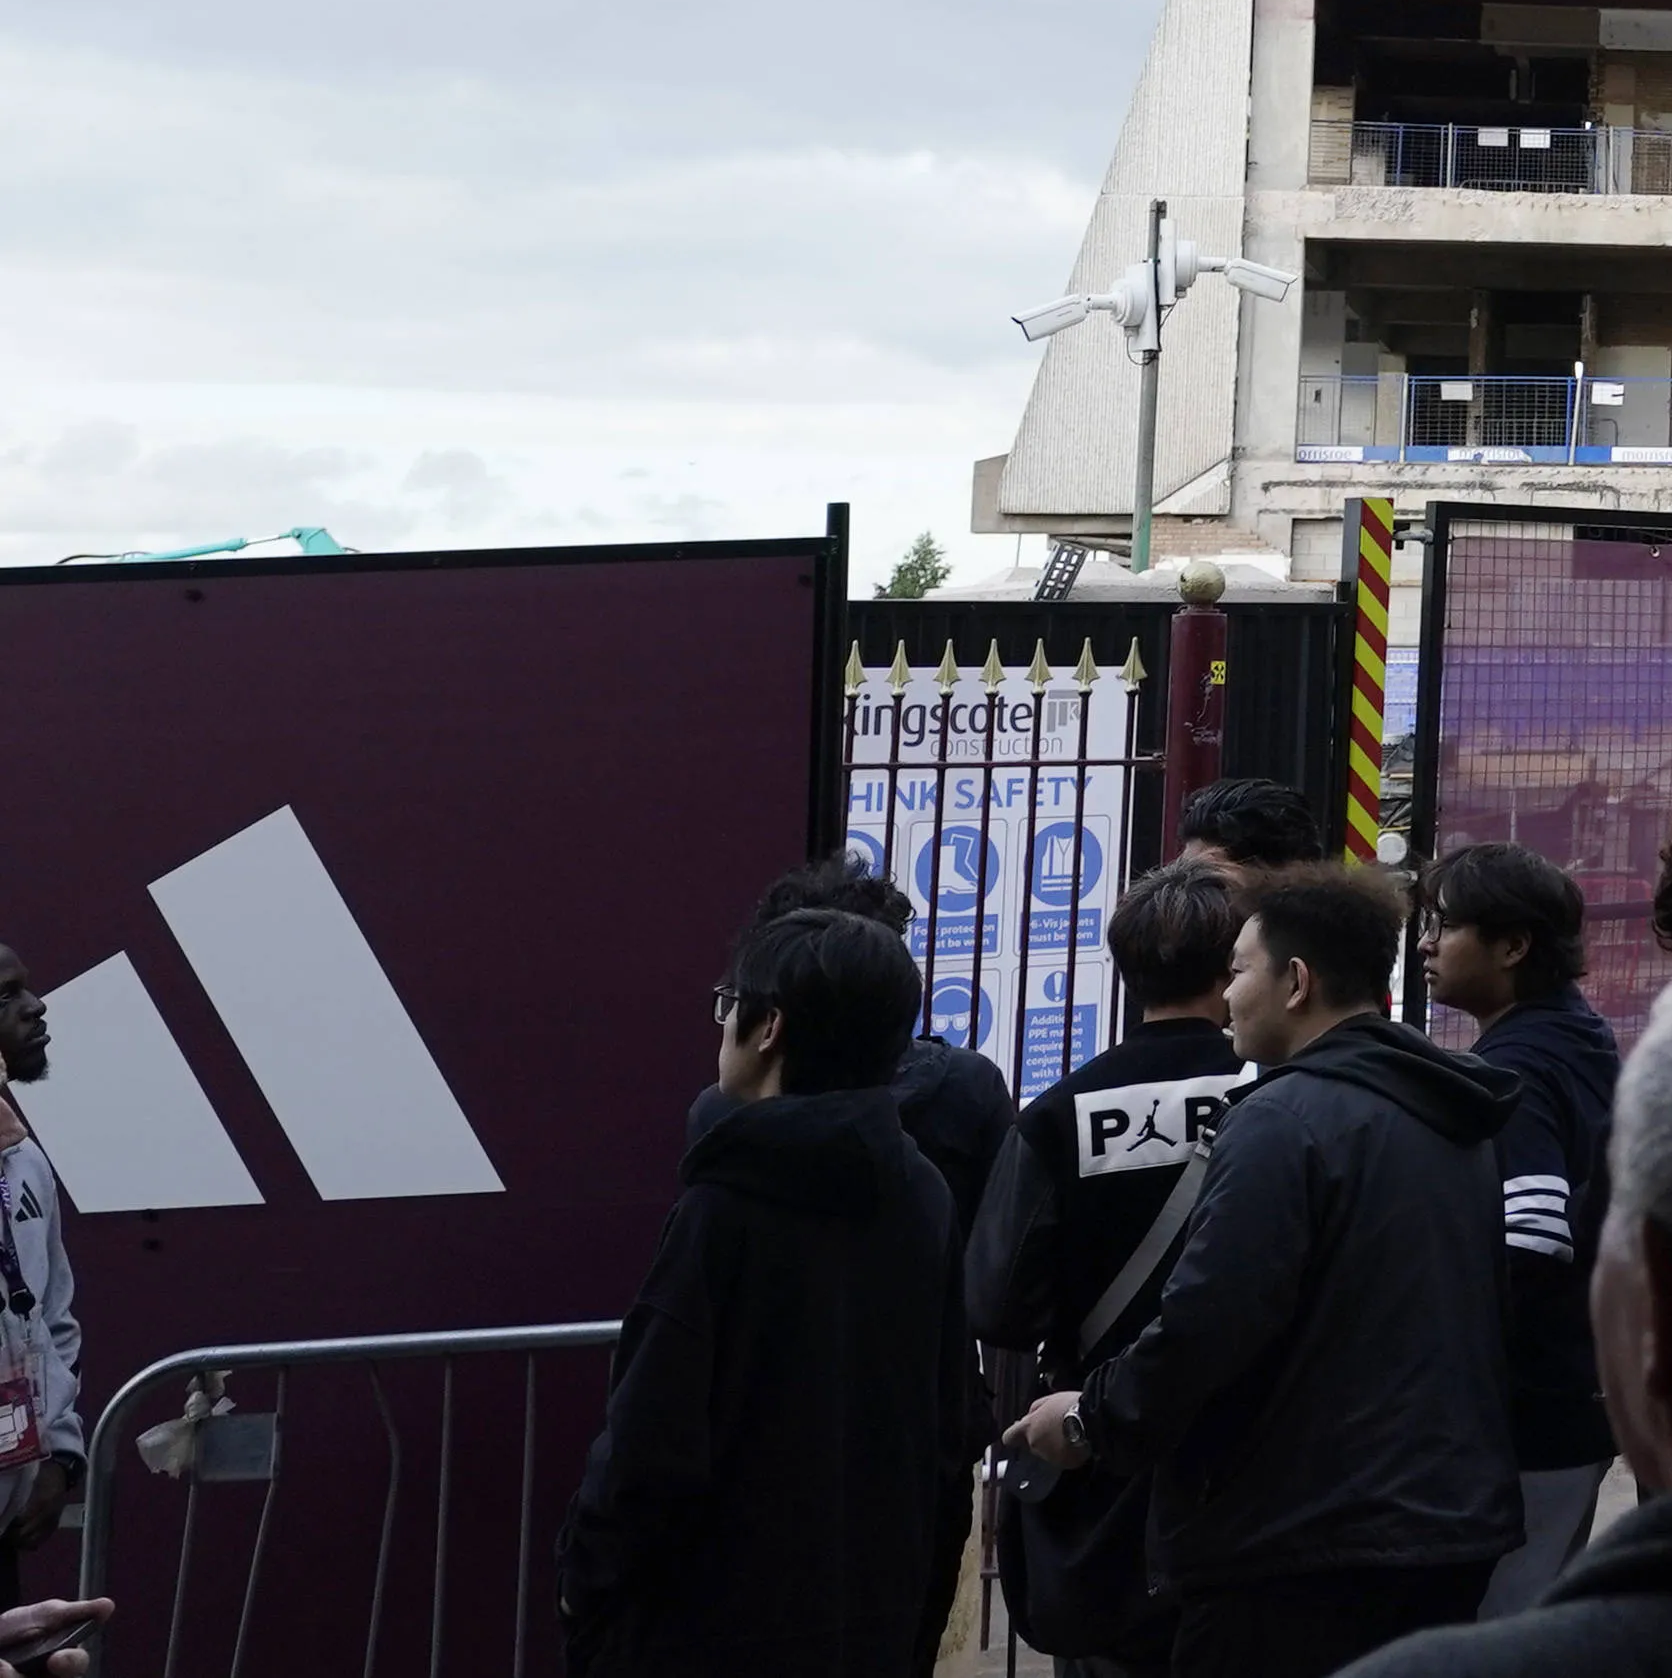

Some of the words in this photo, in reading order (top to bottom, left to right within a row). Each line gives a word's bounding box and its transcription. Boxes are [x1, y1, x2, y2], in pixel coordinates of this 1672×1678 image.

[954, 775, 1093, 810] SAFETY
[940, 924, 996, 936] protecon
[1053, 931, 1066, 941] be
[1028, 1027, 1049, 1039] PPE
[1049, 1029, 1064, 1038] ma
[1028, 1041, 1064, 1054] require
[1031, 1067, 1054, 1079] with
